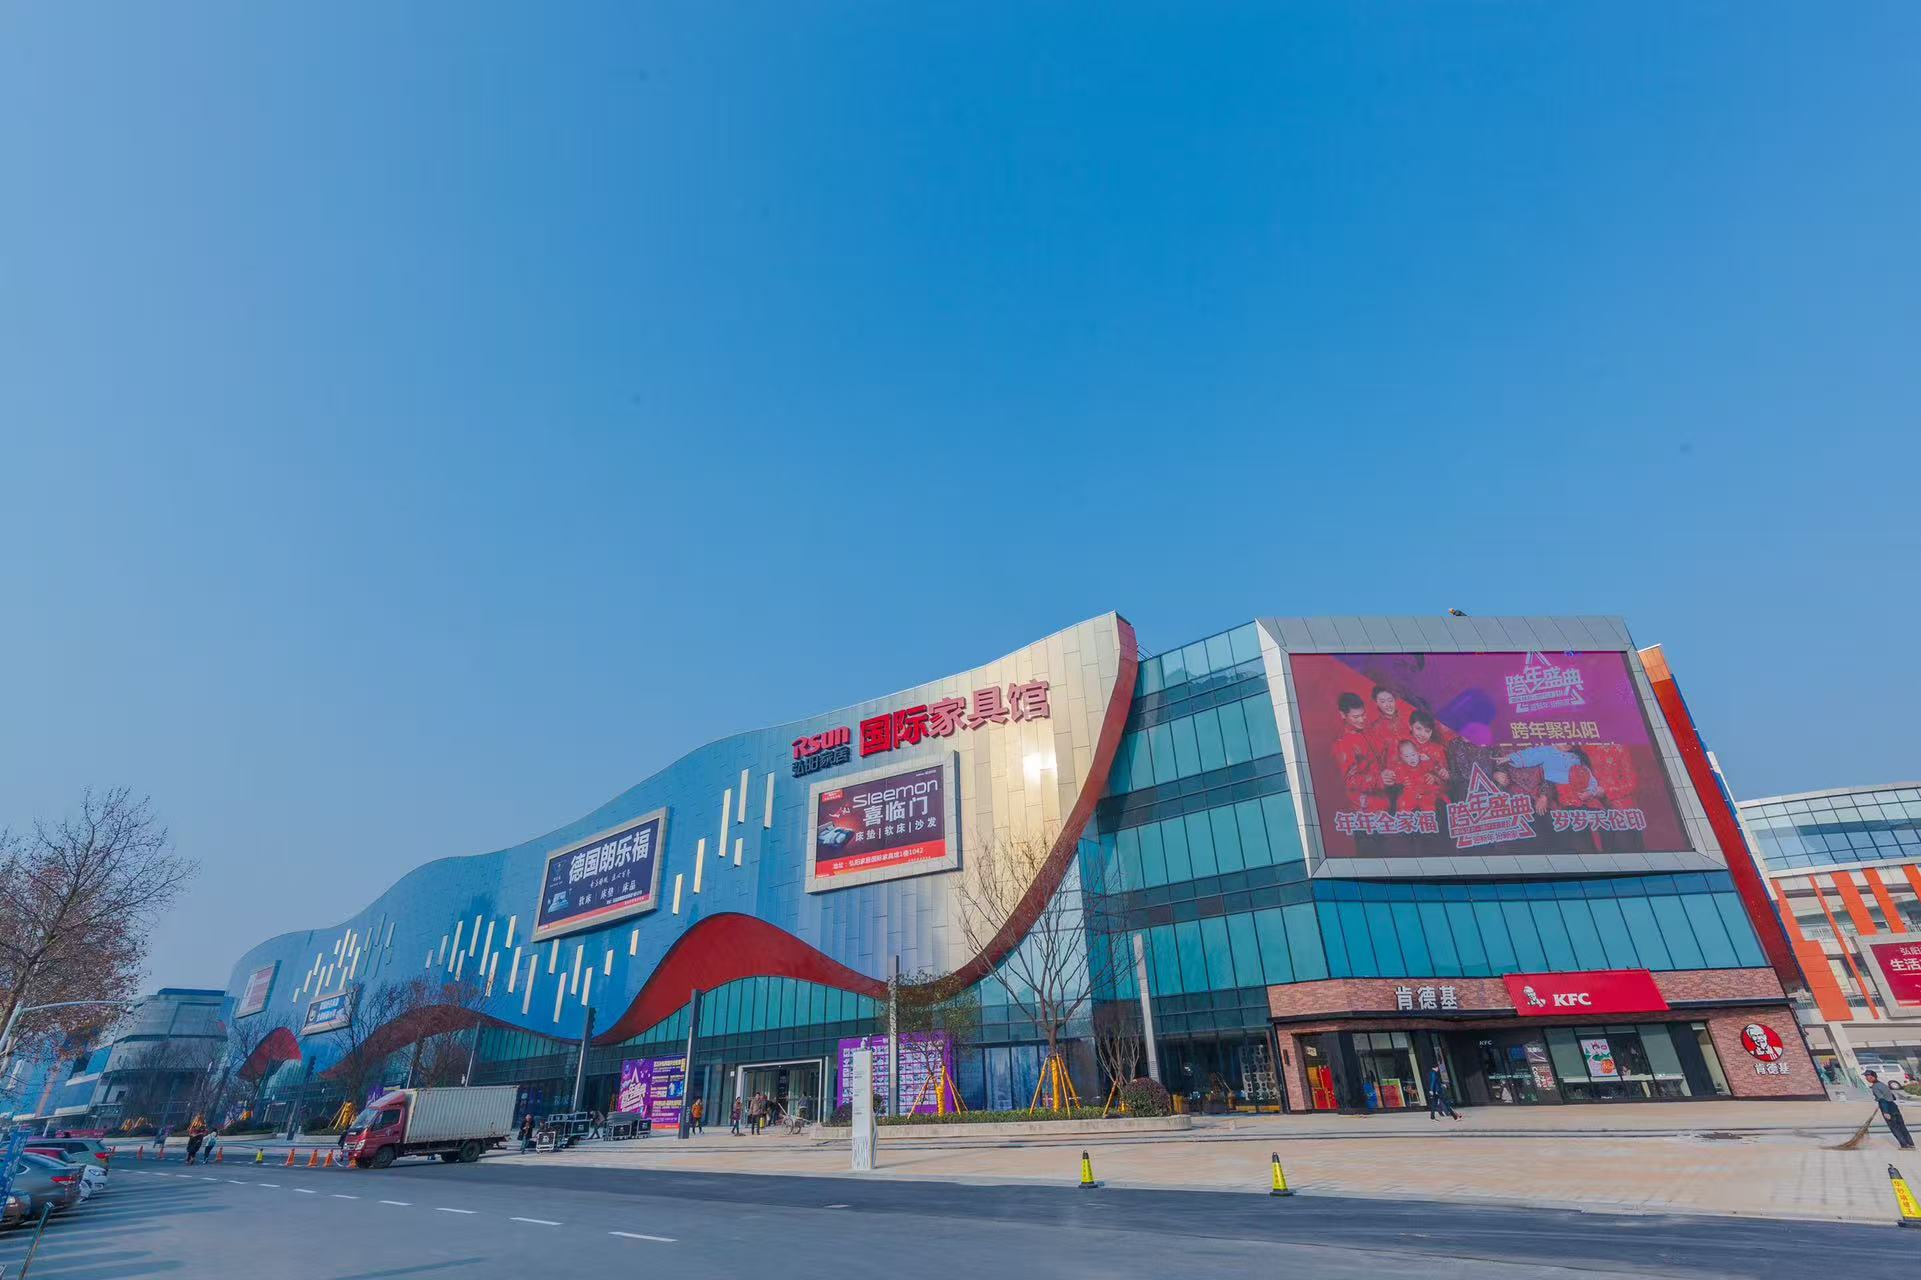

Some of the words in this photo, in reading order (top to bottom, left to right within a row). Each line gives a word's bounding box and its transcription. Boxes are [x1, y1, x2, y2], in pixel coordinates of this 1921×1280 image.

[1505, 665, 1583, 696] 跨年盛典
[859, 679, 1050, 757] 国际家具馆
[1510, 721, 1600, 739] 跨年聚弘阳
[792, 725, 851, 760] Rsun
[792, 747, 851, 778] 弘阳家居
[852, 779, 938, 808] Sleemon
[863, 796, 928, 827] 喜临门
[1335, 810, 1439, 834] 年年全家福
[1447, 792, 1534, 828] 跨年盛典
[569, 828, 651, 884] 德国朗乐福
[1890, 958, 1921, 971] 生活
[1900, 946, 1921, 956] 弘阳
[1395, 986, 1458, 1010] 肯德基
[1552, 993, 1592, 1007] KFC
[1754, 1062, 1791, 1075] 肯德基
